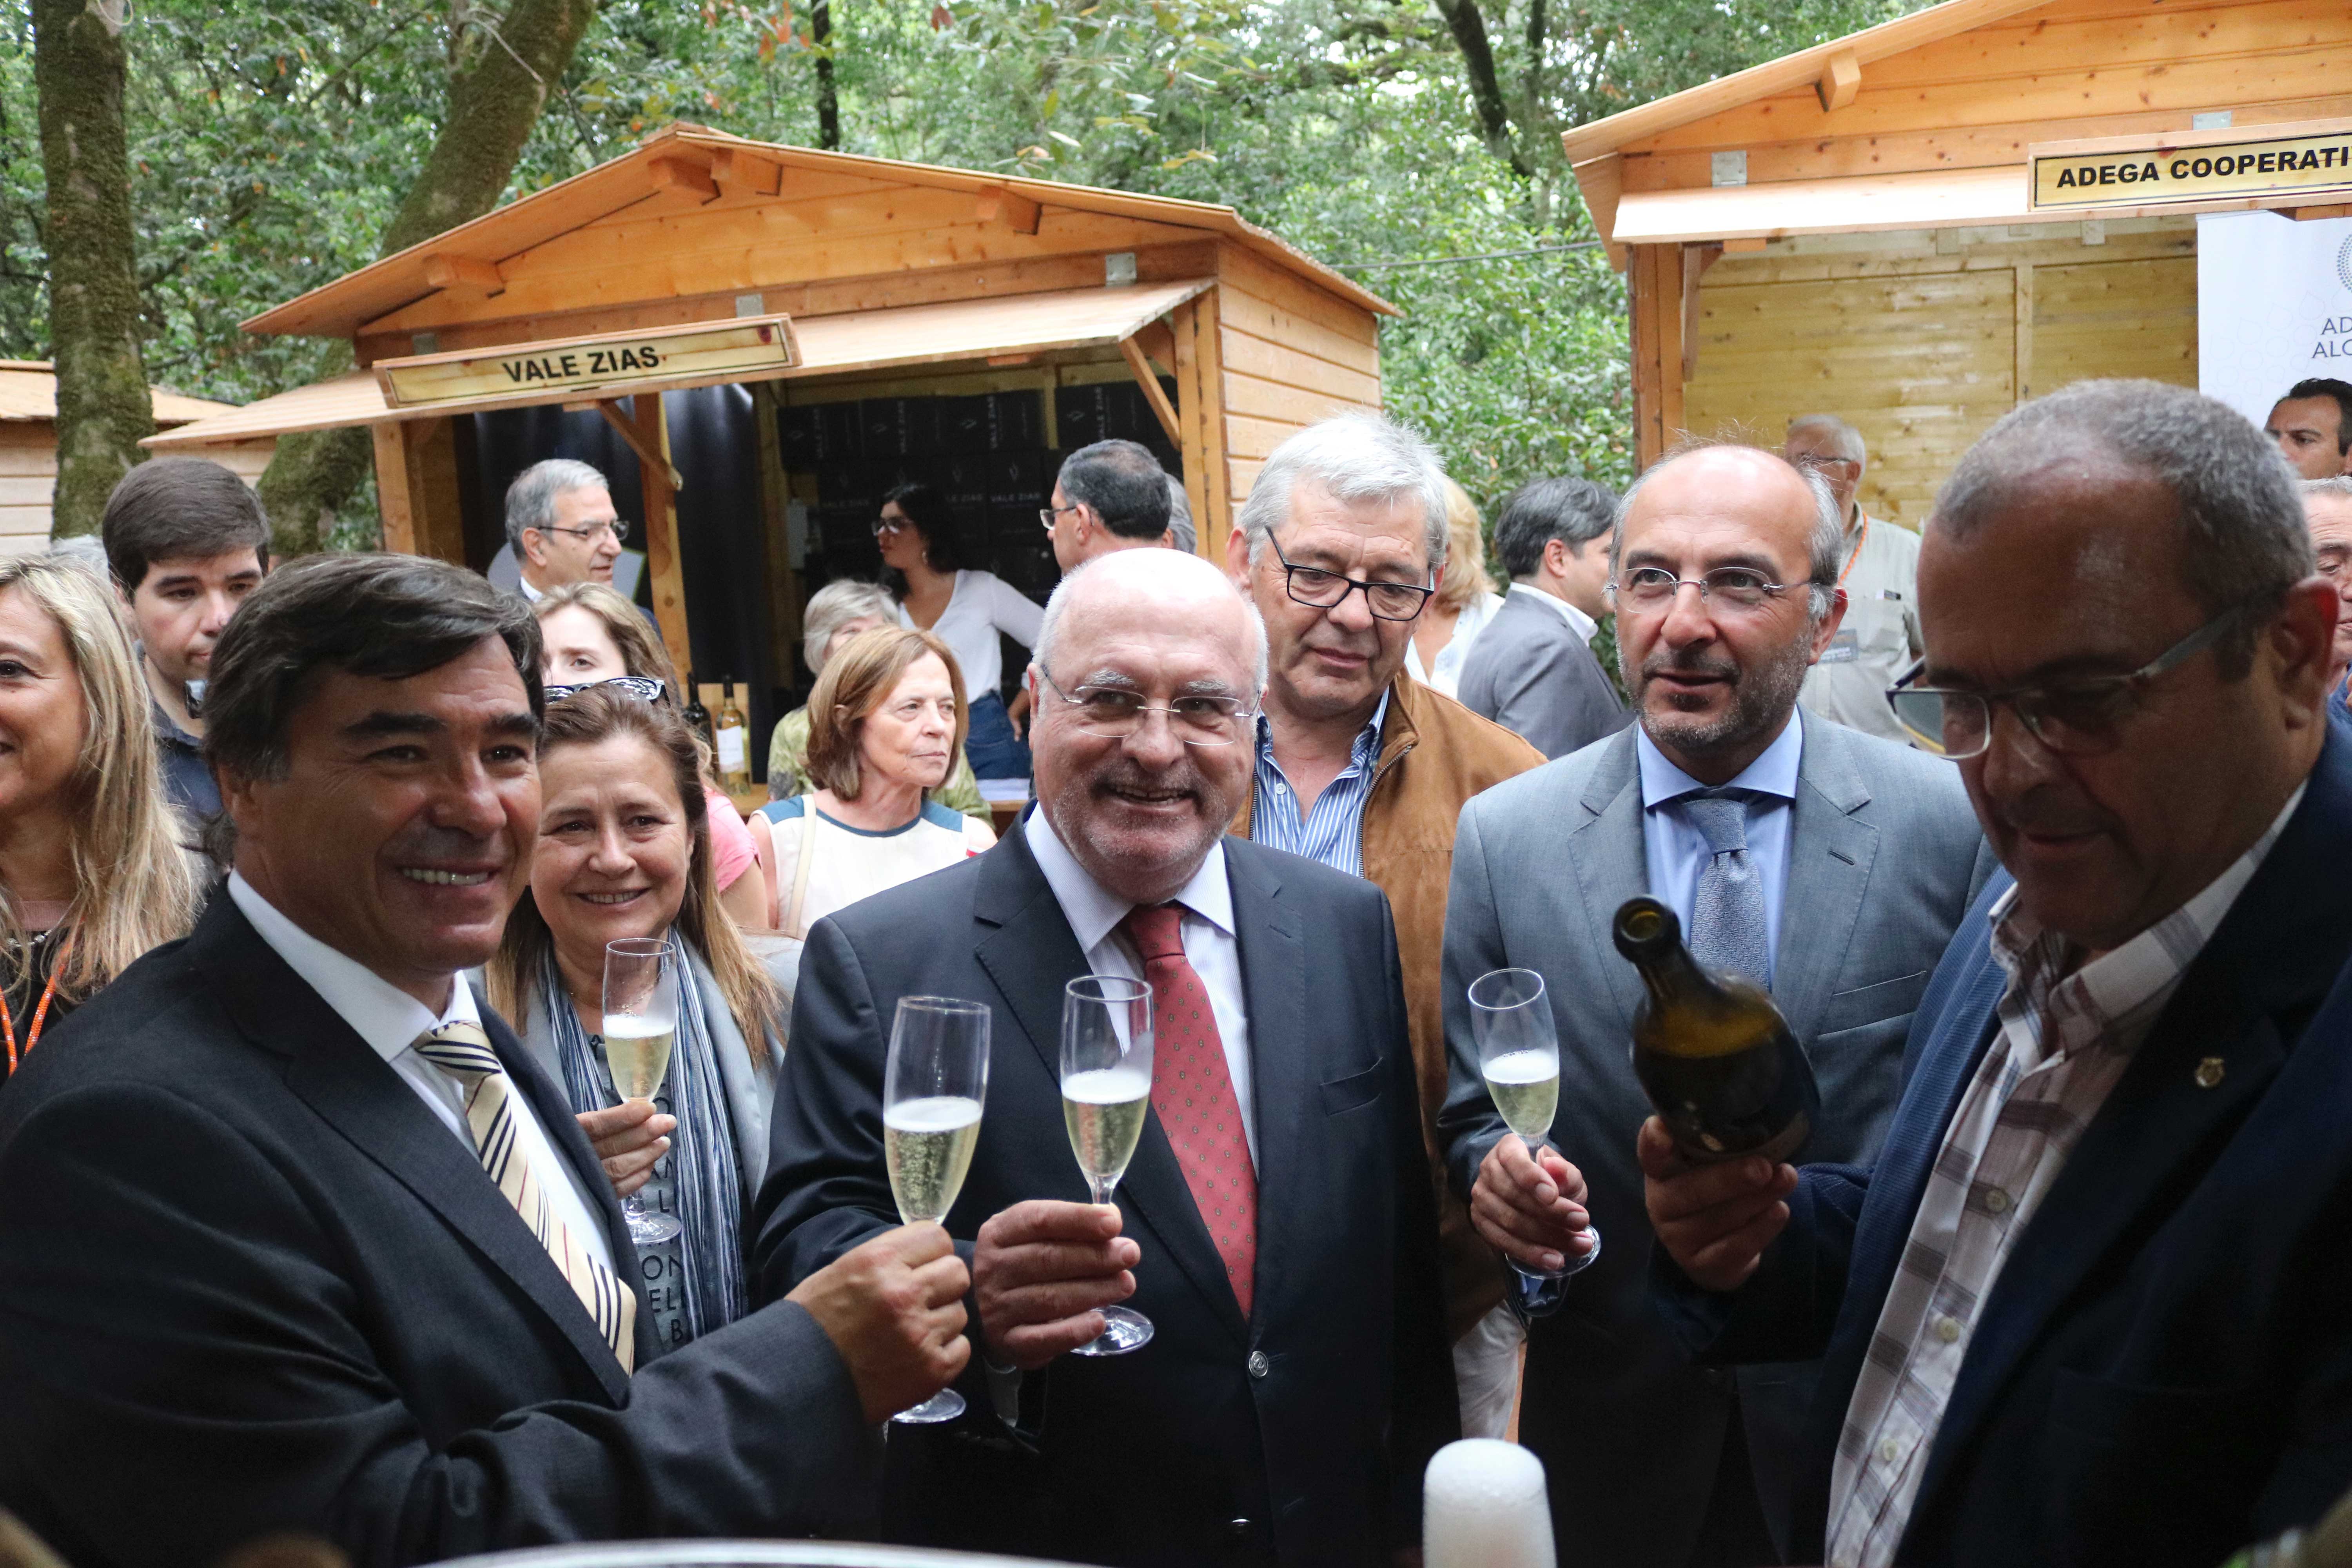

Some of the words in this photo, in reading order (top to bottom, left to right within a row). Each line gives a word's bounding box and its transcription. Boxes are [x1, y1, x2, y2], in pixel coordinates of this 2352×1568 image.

[2057, 162, 2160, 188] ADEGA
[2170, 146, 2352, 179] COOPERATI
[502, 355, 581, 382] VALE
[588, 346, 659, 374] ZIAS
